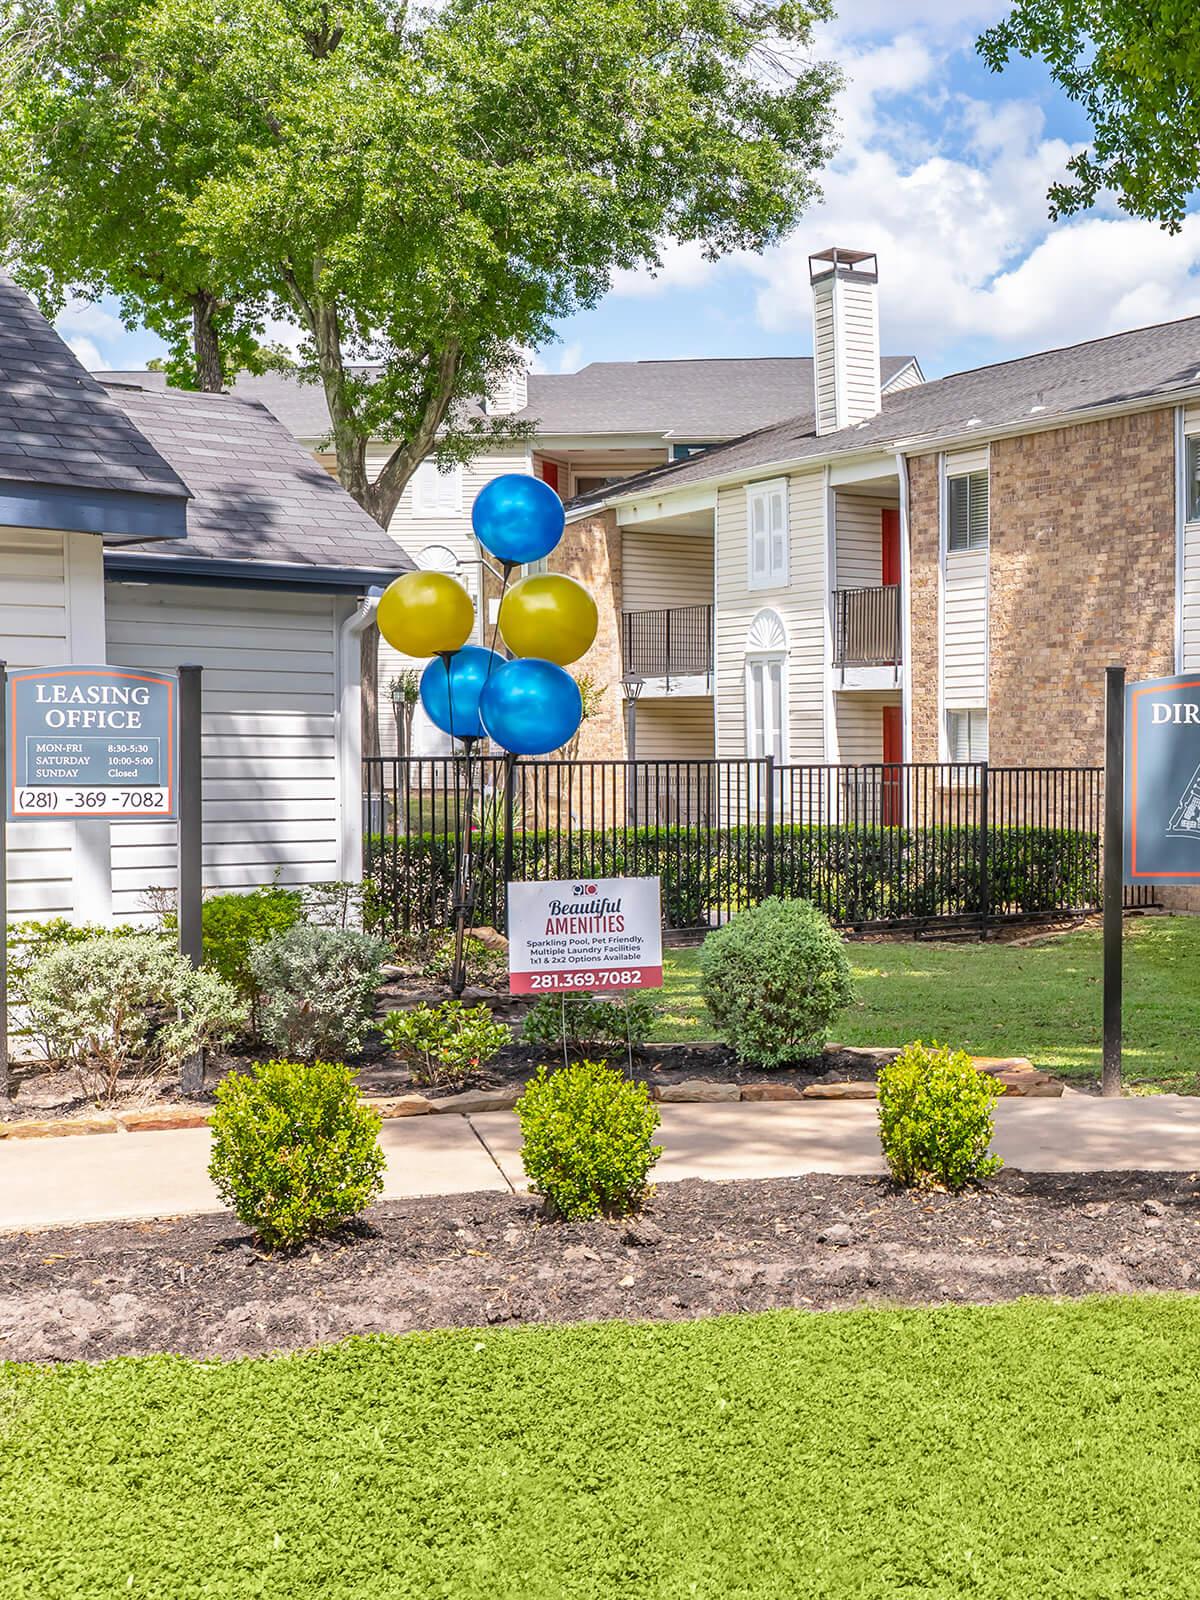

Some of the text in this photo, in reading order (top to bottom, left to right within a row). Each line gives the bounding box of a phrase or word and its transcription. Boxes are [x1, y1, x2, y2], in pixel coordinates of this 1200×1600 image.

[36, 685, 150, 704] LEASING
[45, 709, 142, 729] OFFICE
[35, 744, 148, 753] MON-FRI 8:30-5:30
[35, 757, 153, 765] SATURDAY 10:00-5:00
[35, 769, 138, 777] SUNDAY Closed
[19, 791, 164, 810] (281) -369 -7082
[549, 898, 622, 918] Beautiful
[545, 915, 625, 935] AMENITIES
[526, 938, 567, 948] Sparkling
[530, 944, 641, 956] Multiple Laundry Facilities
[568, 954, 602, 963] Options
[603, 953, 641, 961] Available
[530, 971, 642, 988] 281.369.7082
